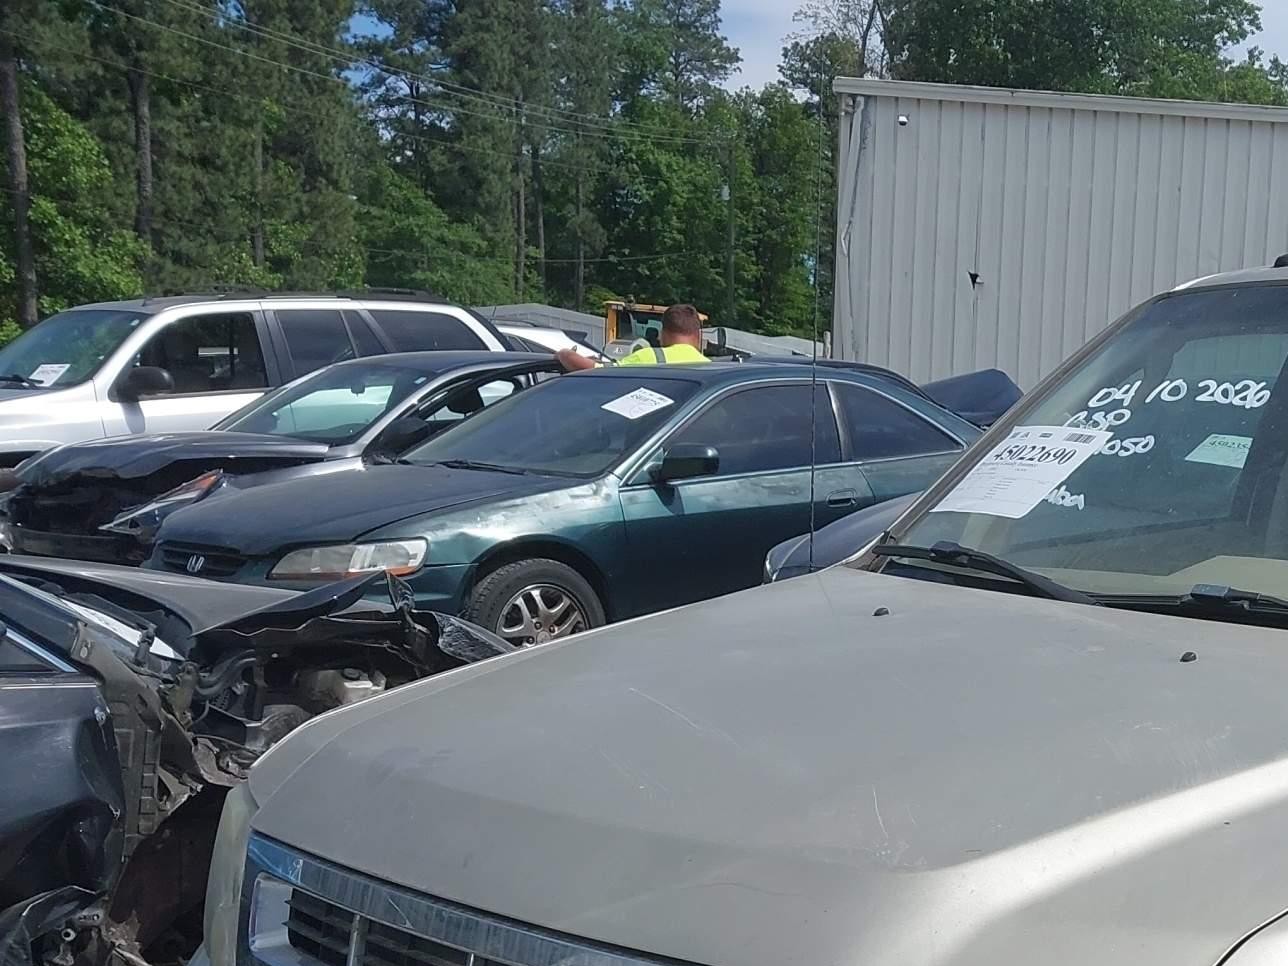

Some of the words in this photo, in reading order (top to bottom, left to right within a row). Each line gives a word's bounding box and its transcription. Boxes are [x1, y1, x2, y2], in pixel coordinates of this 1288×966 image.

[1088, 380, 1142, 407] 04
[1195, 380, 1271, 408] 2026
[994, 444, 1077, 465] 45022690
